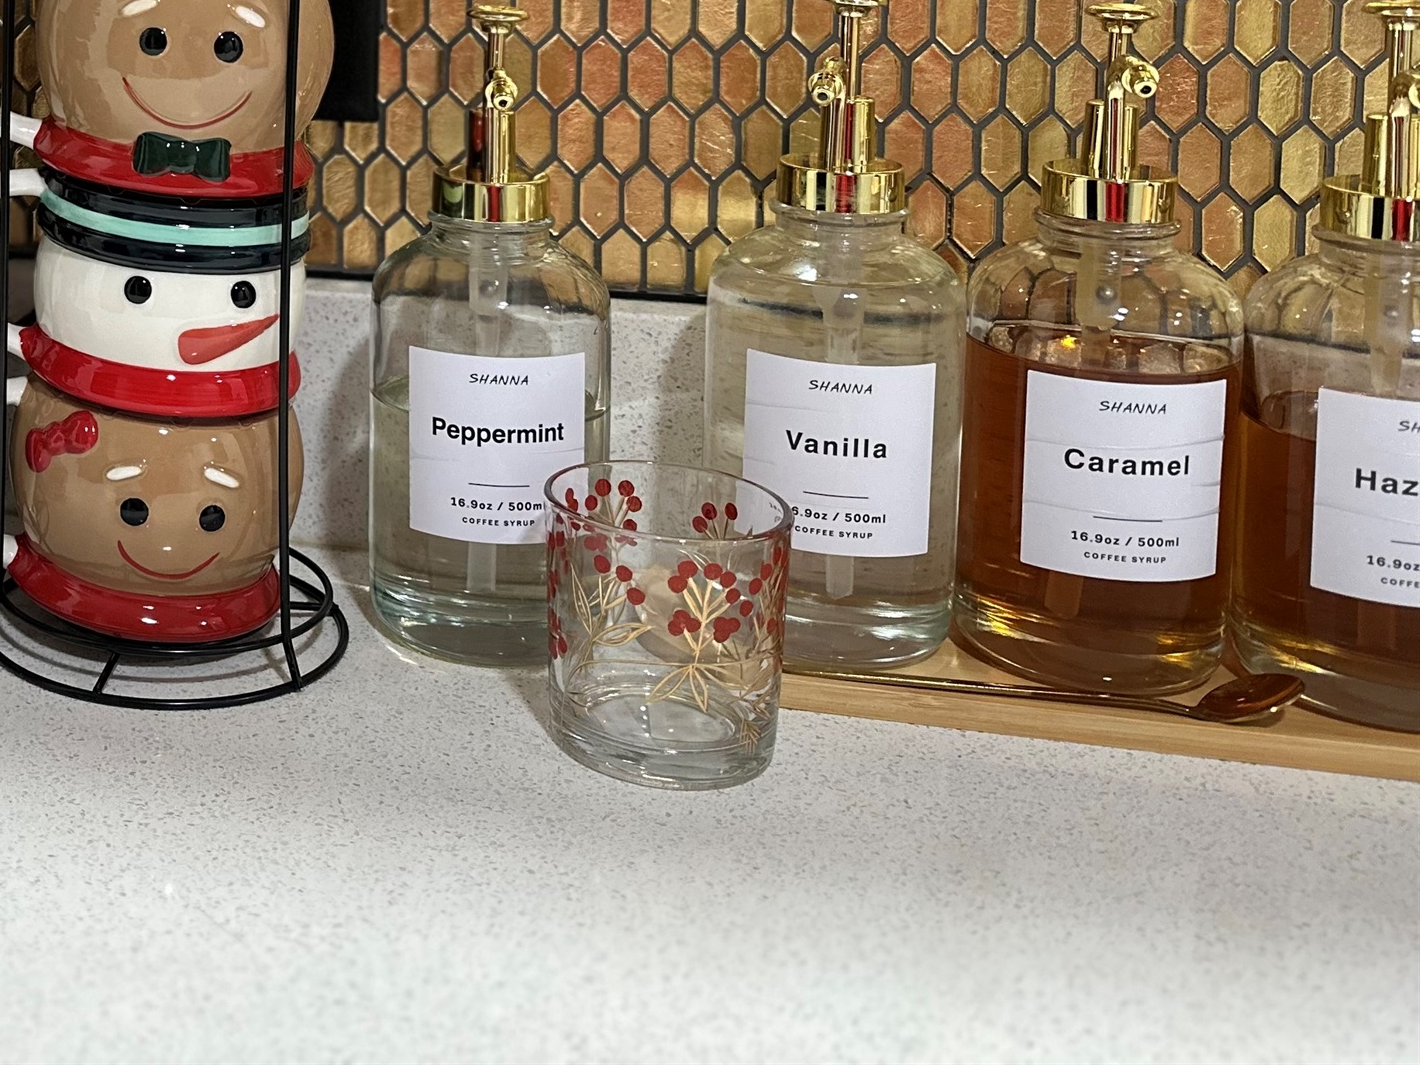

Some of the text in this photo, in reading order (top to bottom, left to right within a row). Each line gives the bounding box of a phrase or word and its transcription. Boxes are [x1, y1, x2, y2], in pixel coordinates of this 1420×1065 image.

[469, 373, 530, 386] SHANNA
[808, 379, 873, 395] SHANNA
[1099, 400, 1167, 415] SHANNA
[432, 416, 564, 447] Peppermint
[785, 429, 887, 459] Vanilla
[1064, 448, 1190, 476] Caramel
[1355, 467, 1419, 497] Haz
[450, 496, 493, 511] 16.9oz
[497, 501, 504, 511] /
[462, 516, 535, 527] COFFEE SYRUP
[832, 512, 840, 522] /
[844, 513, 886, 524] 500ml
[794, 525, 873, 539] COFFEE SYRUP
[1071, 530, 1180, 548] 16.9oz / 500ml
[1083, 551, 1167, 564] COFFEE SYRUP
